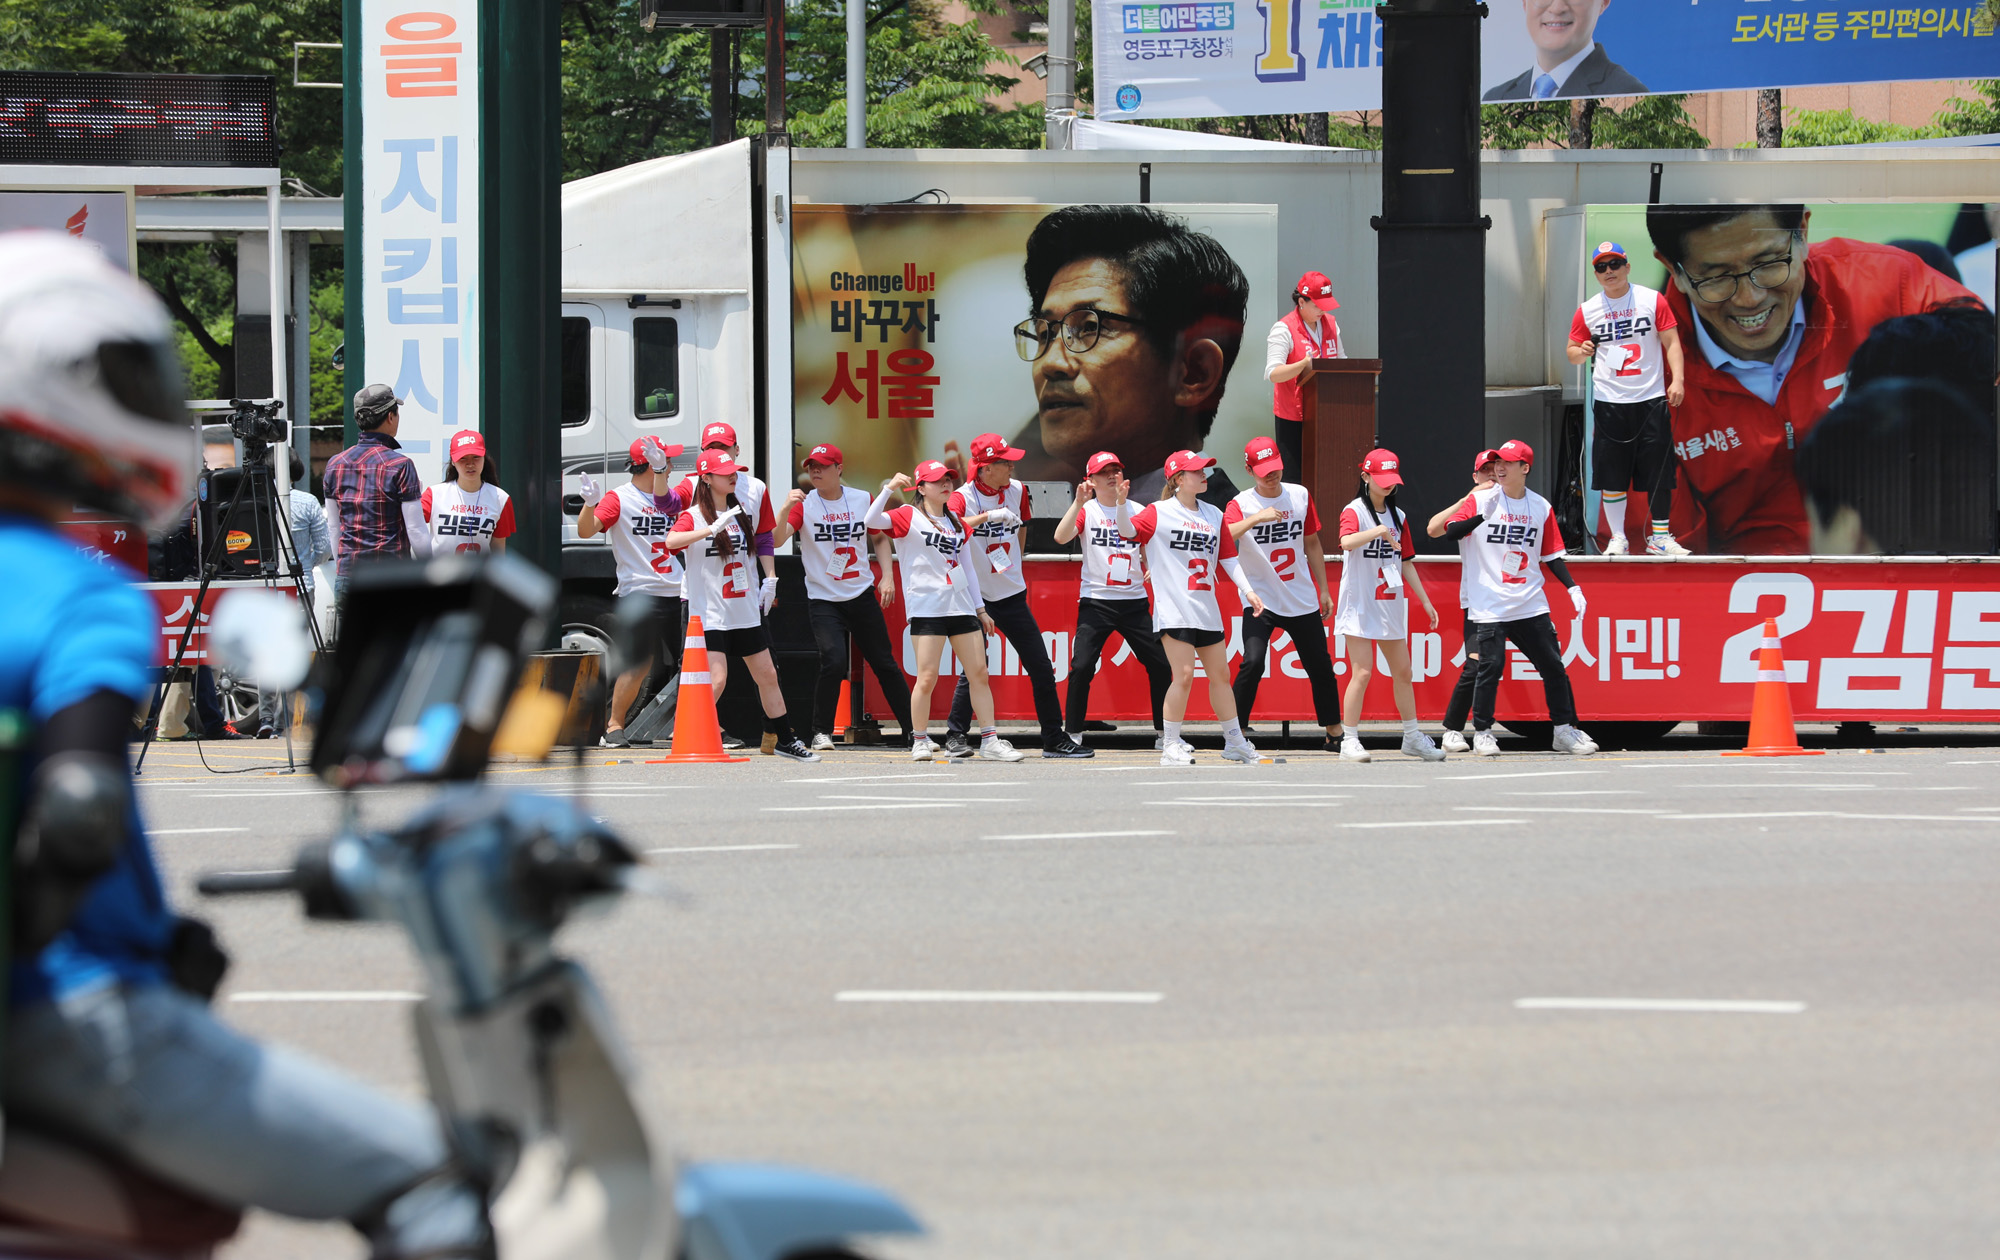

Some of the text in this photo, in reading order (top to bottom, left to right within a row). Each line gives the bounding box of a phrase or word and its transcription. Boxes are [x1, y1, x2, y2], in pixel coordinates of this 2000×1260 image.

[1124, 5, 1233, 30] 더불어민주당
[1732, 13, 1809, 43] 도서관
[1812, 12, 1839, 42] 등
[1123, 37, 1224, 61] 영등포구청장
[1256, 0, 1306, 83] 1
[380, 12, 462, 98] 을
[831, 299, 940, 343] 바꾸자
[1596, 316, 1652, 343] 김문수
[821, 349, 940, 419] 서울
[986, 447, 994, 457] 2
[1364, 460, 1371, 469] 2
[701, 461, 707, 471] 2
[1170, 461, 1177, 471] 2
[438, 514, 495, 538] 김문수
[1252, 520, 1303, 544] 김문수
[1486, 524, 1538, 547] 김문수
[1170, 530, 1217, 554] 김문수
[651, 542, 672, 574] 2
[1270, 548, 1296, 582] 2
[1188, 558, 1212, 591] 2
